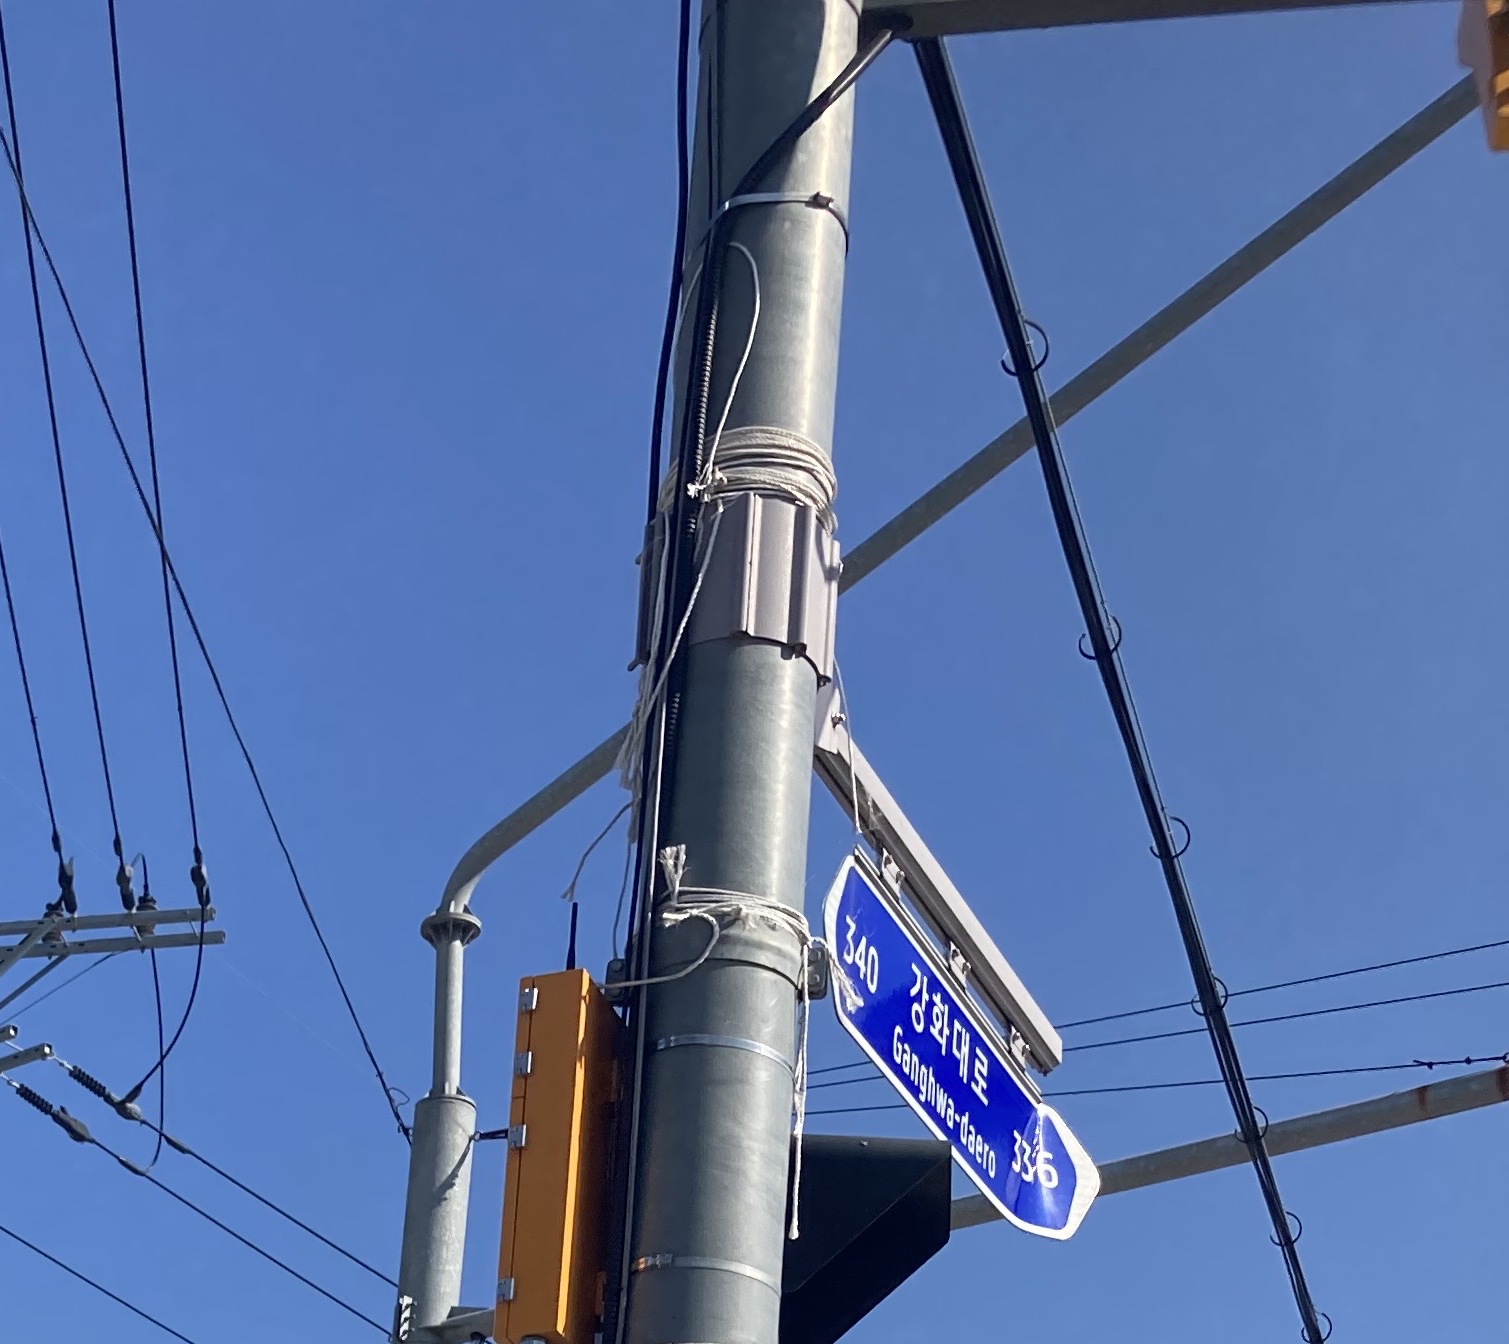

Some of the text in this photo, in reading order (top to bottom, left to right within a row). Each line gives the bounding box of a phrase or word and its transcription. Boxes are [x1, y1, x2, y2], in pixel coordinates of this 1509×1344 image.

[842, 915, 880, 995] 340
[909, 963, 990, 1107] 강화대로
[892, 1024, 996, 1181] Ganghwa-daero
[1011, 1129, 1059, 1190] 336
